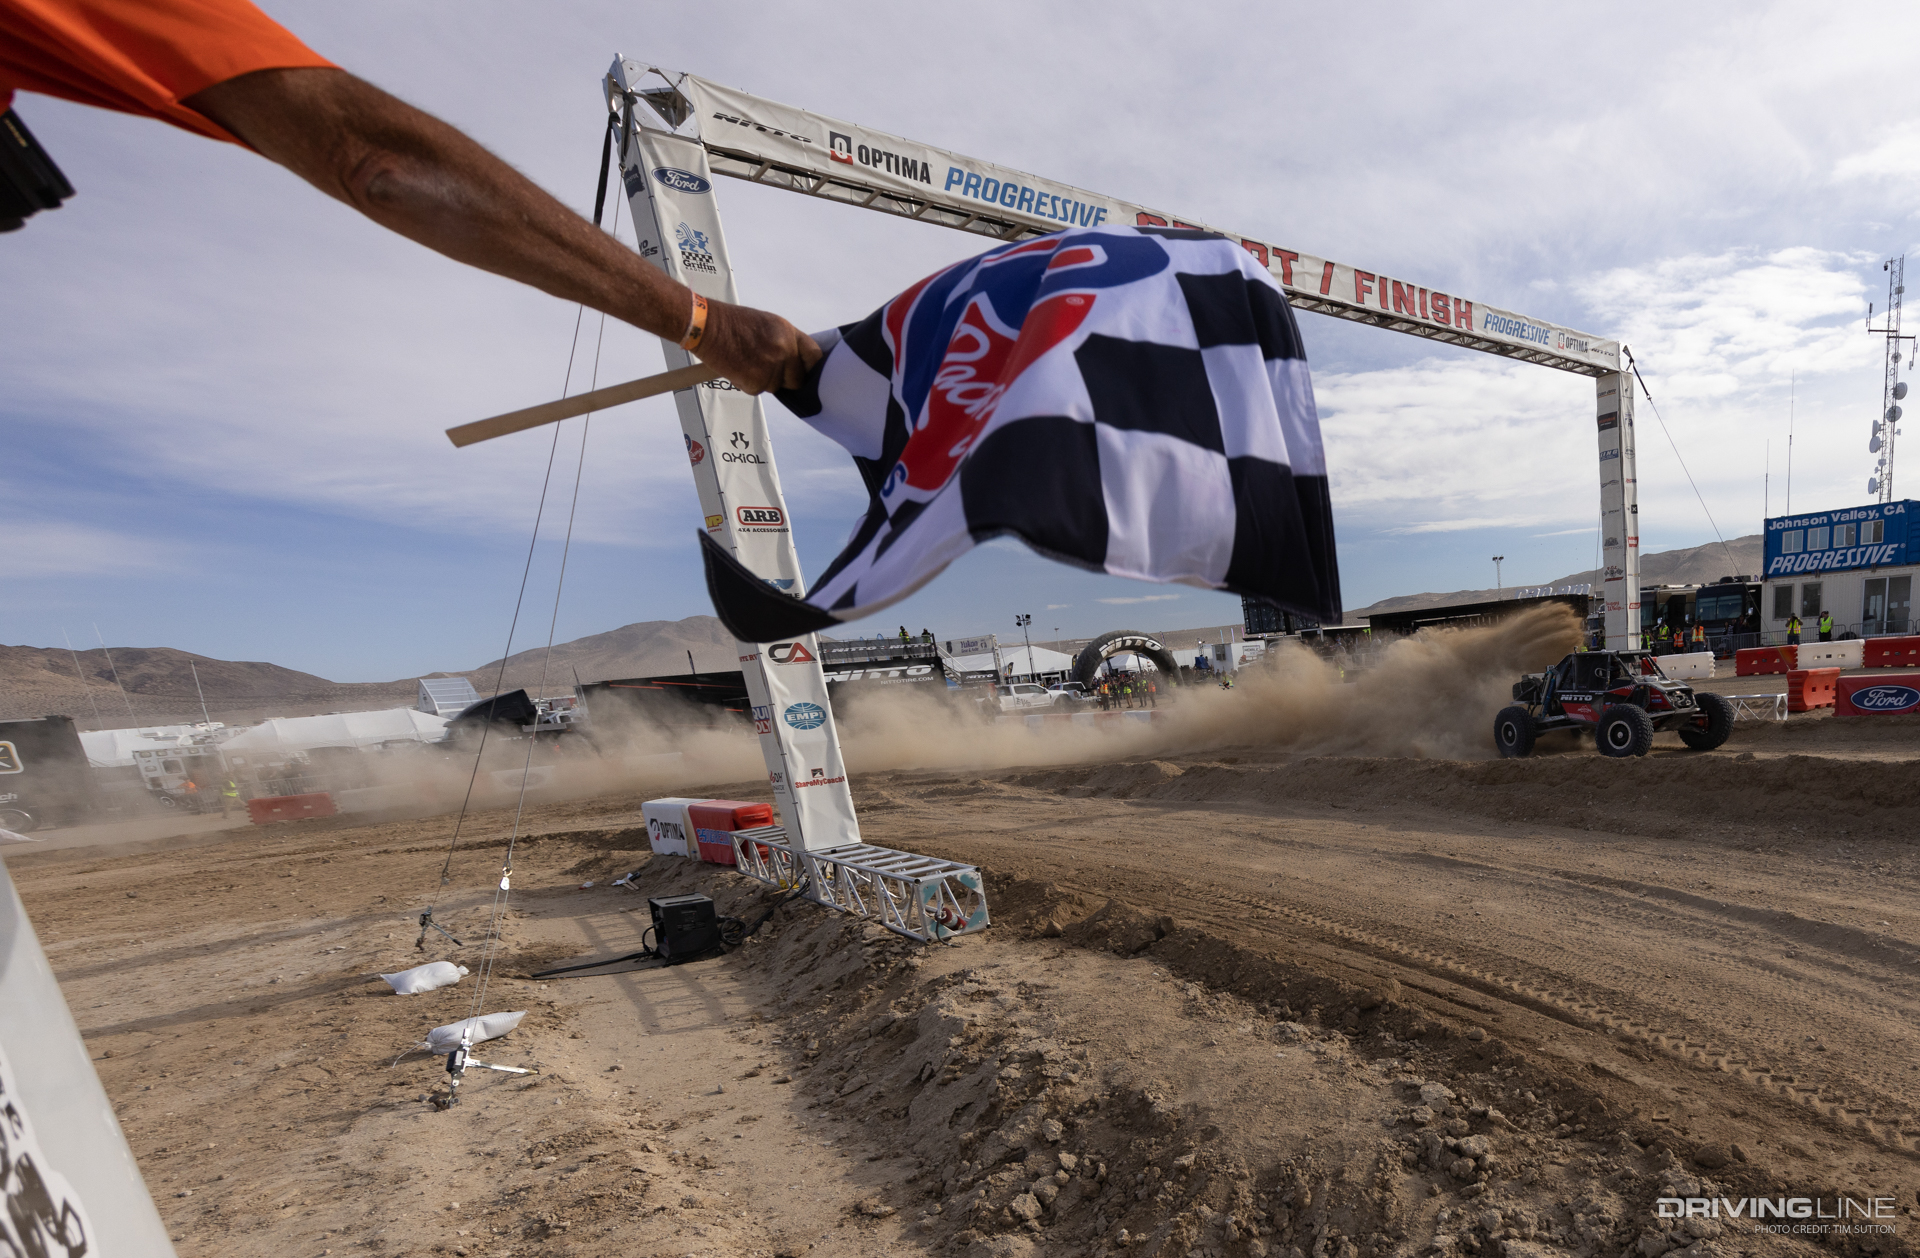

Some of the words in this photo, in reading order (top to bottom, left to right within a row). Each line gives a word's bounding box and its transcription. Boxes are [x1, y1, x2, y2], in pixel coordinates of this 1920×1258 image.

[857, 143, 931, 184] OPTIMA
[664, 171, 700, 191] Ford
[944, 166, 1107, 227] PROGRESSIVE
[683, 259, 717, 272] Griffin
[1354, 268, 1474, 332] FINISH
[1483, 312, 1551, 345] PROGRESSIVE
[1565, 336, 1588, 353] OPTIMA
[701, 379, 741, 391] RECA
[743, 510, 781, 522] ARB
[1768, 515, 1828, 531] Johnson
[1831, 509, 1879, 523] Valley,
[1883, 504, 1905, 516] CA
[1768, 543, 1898, 575] PROGRESSIVE
[960, 640, 979, 649] Yukon
[880, 676, 934, 685] NITTOTIRE.COM
[1863, 688, 1909, 706] Ford
[786, 711, 824, 721] EMPI
[660, 821, 685, 841] OPTIMA
